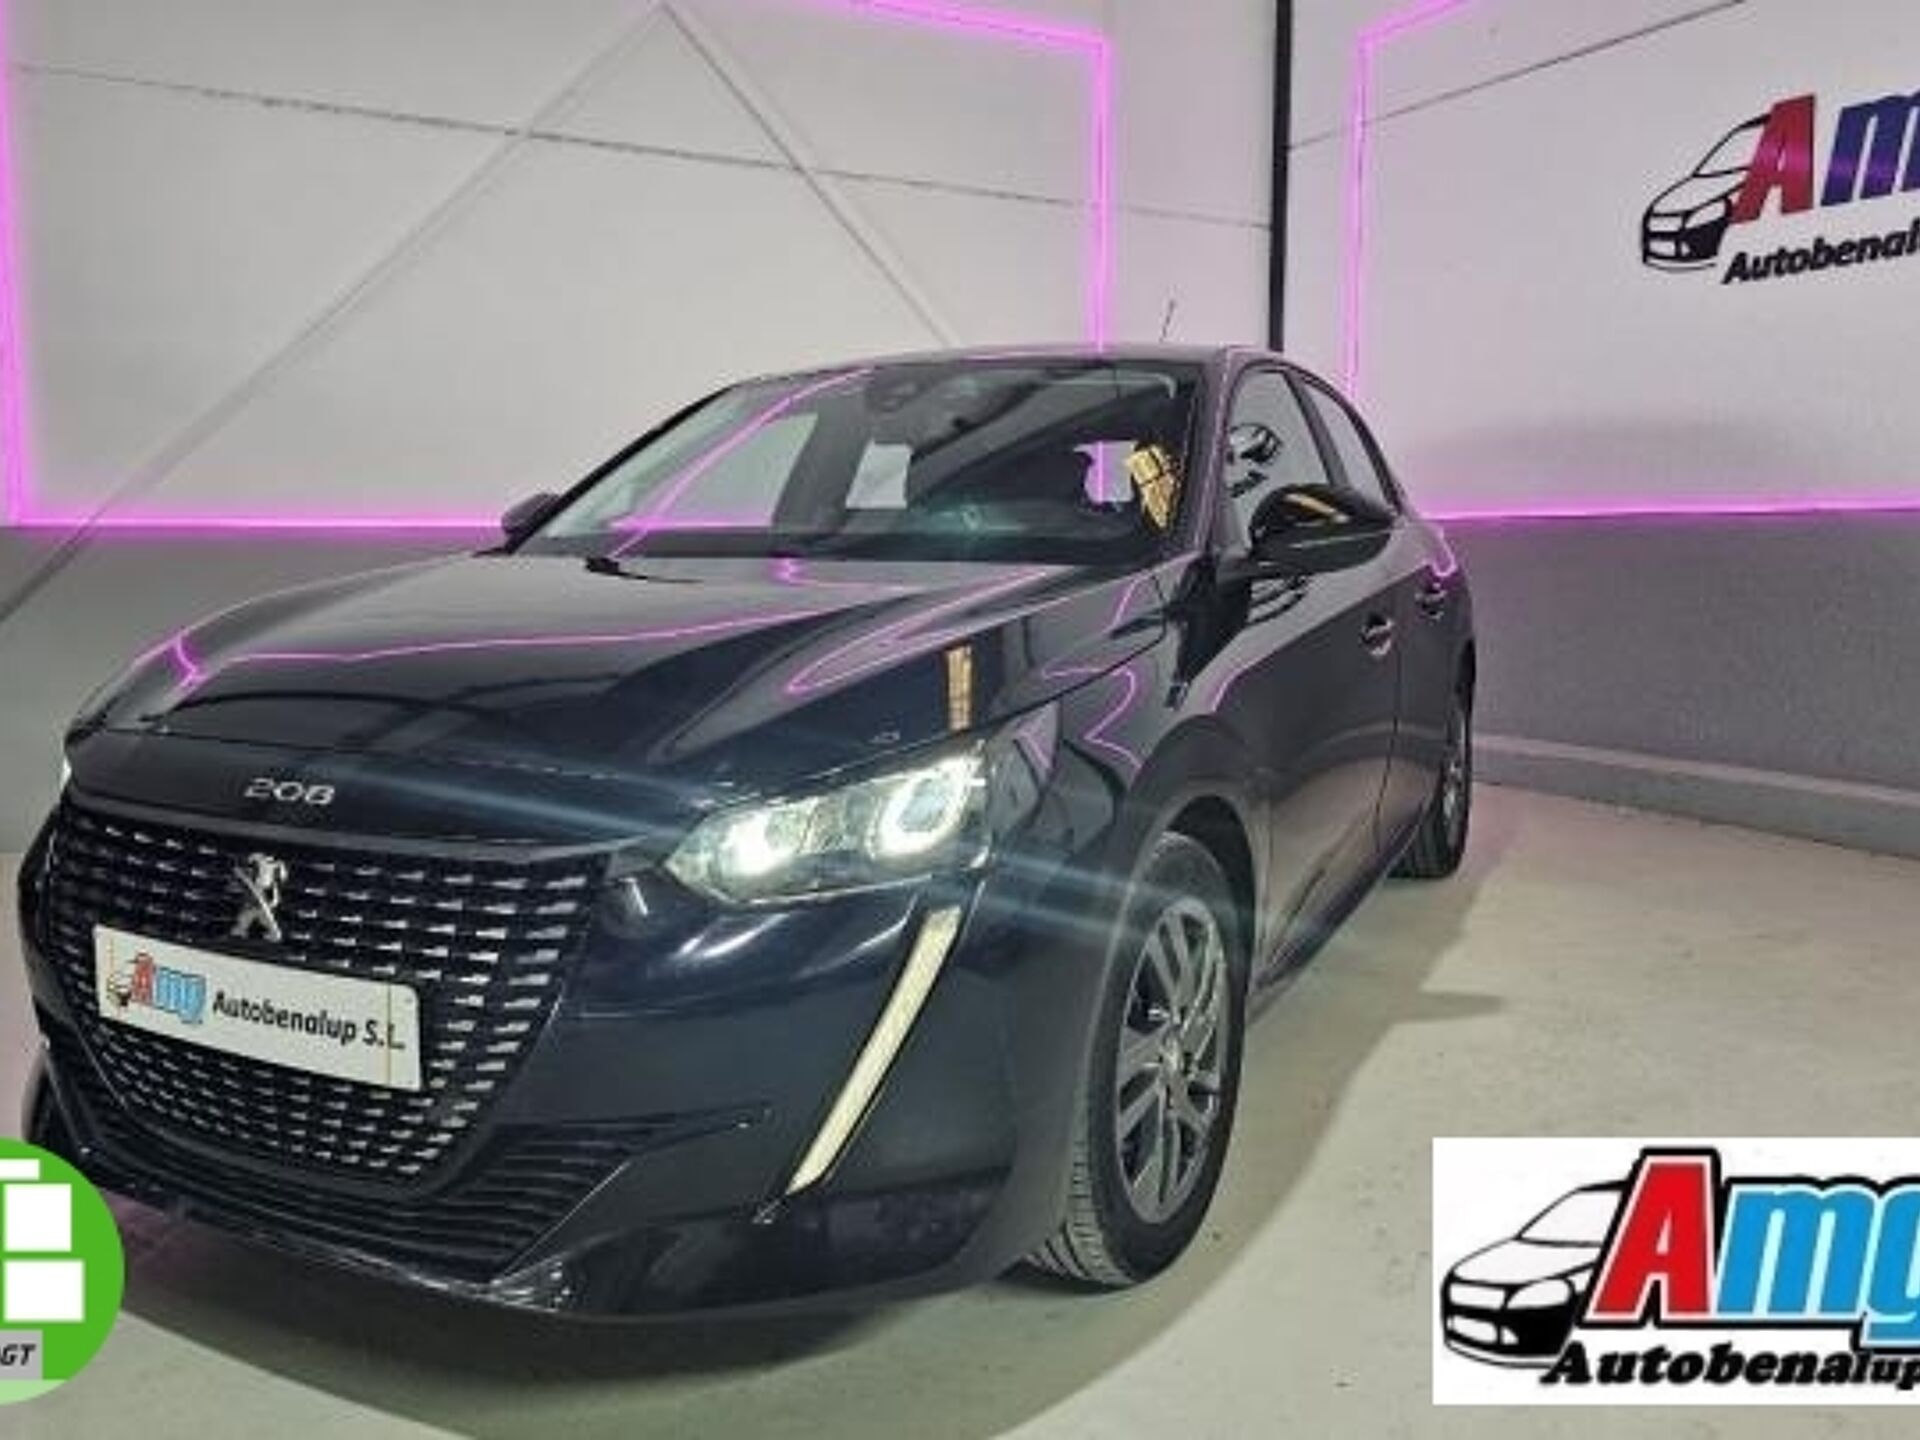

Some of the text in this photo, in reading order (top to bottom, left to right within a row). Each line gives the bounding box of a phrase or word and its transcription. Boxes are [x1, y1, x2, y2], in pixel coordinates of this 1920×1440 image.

[243, 777, 336, 805] 208
[130, 952, 207, 1025] Amg
[212, 989, 357, 1046] Autobenalup
